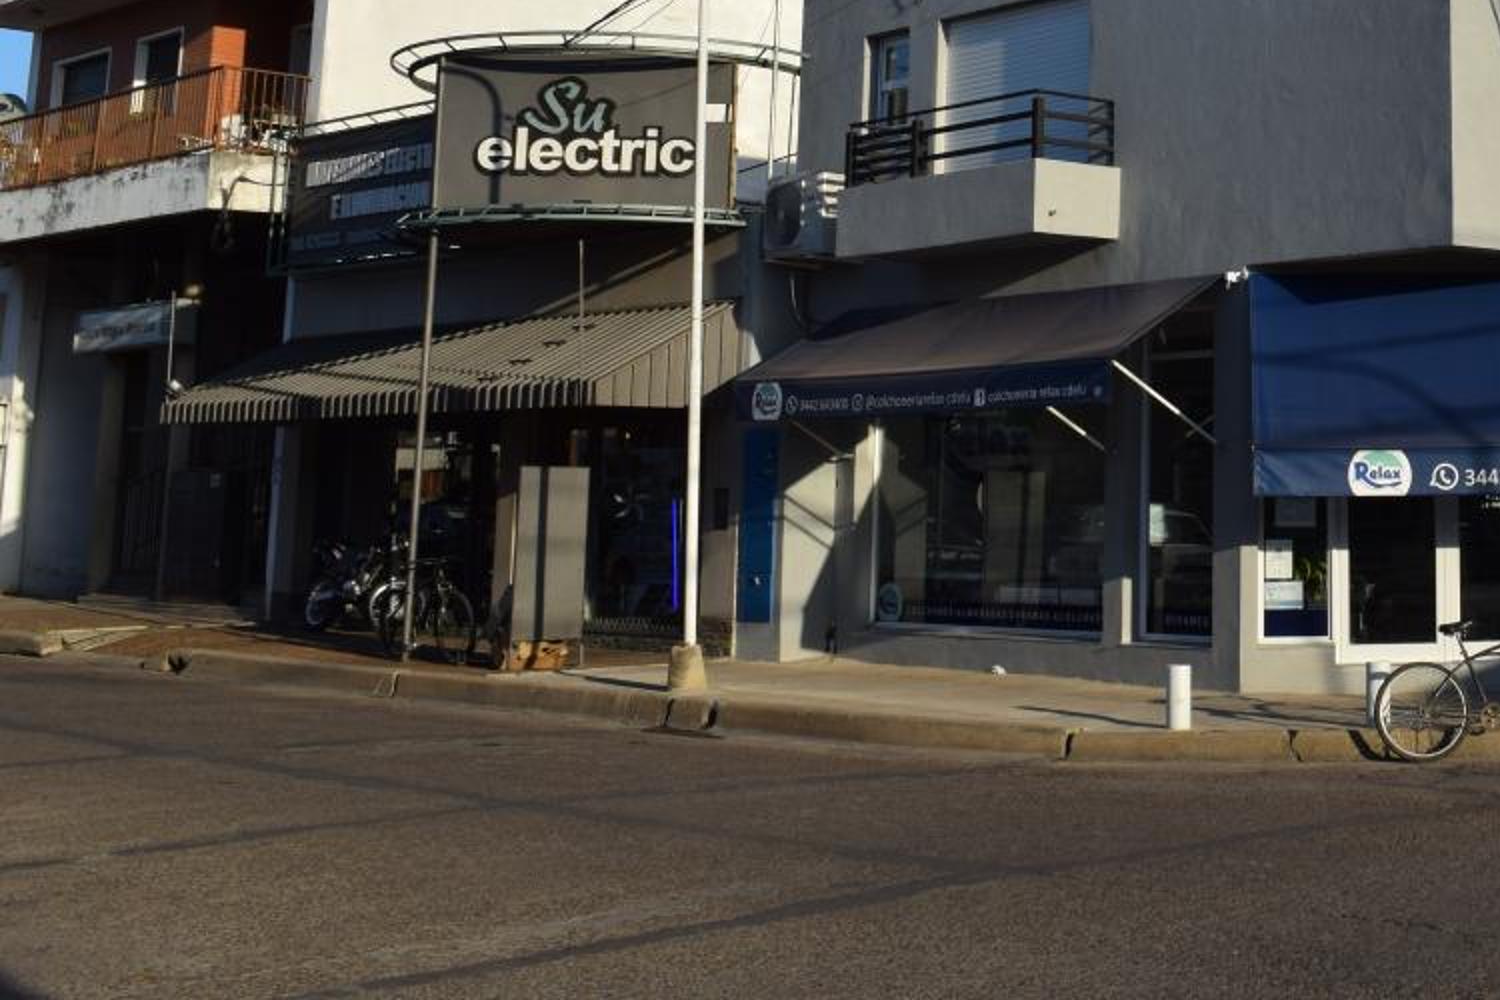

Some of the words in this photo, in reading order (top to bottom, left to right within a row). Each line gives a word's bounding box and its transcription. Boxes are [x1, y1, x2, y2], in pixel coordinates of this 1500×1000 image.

[522, 80, 608, 135] Su
[476, 126, 696, 173] electric
[1353, 460, 1402, 488] Relax
